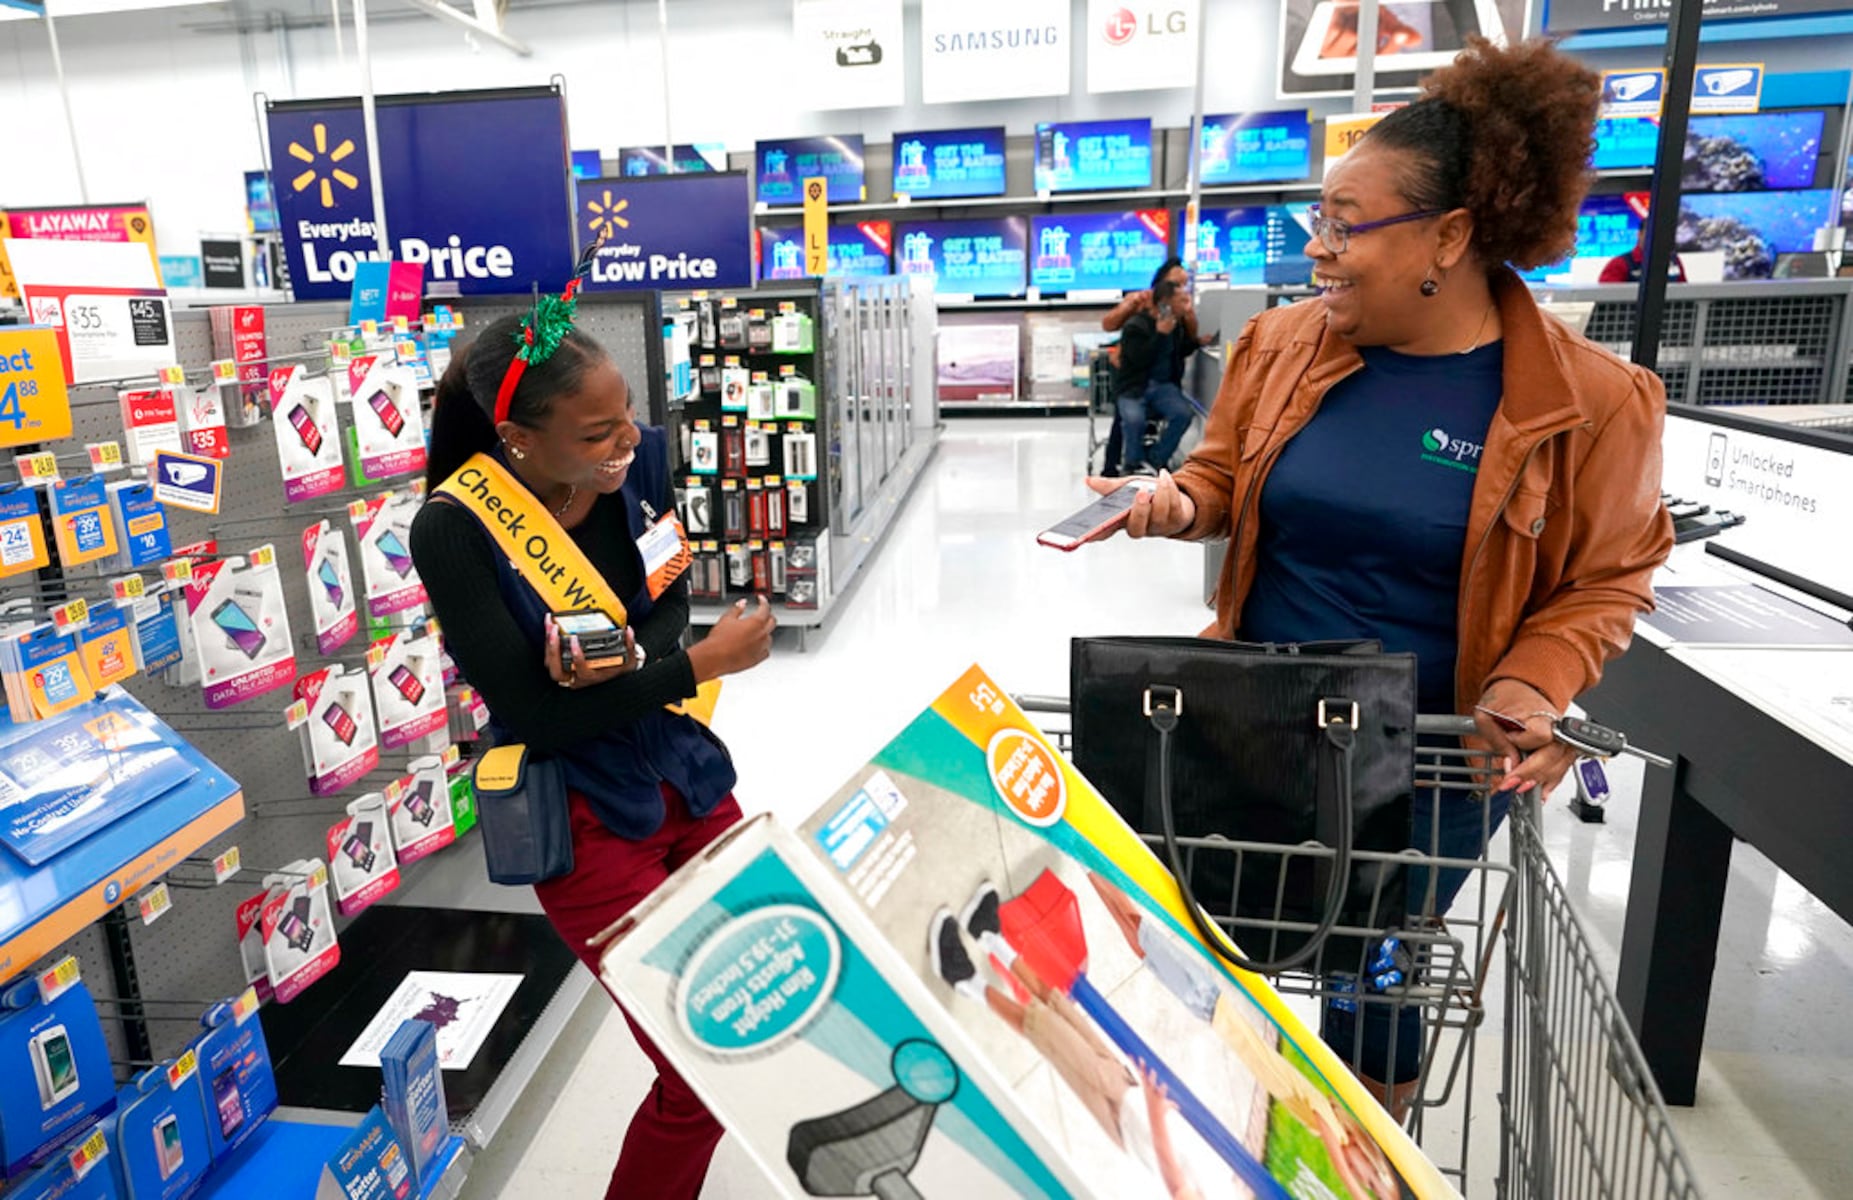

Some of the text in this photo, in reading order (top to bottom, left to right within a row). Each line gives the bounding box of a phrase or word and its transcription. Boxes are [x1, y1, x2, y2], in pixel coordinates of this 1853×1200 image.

[1147, 10, 1186, 35] LG
[823, 28, 872, 41] Straight
[934, 26, 1058, 53] SAMSUNG
[934, 143, 985, 157] GET THE
[1078, 135, 1131, 149] GET THE
[935, 154, 1004, 169] TOP RATED
[1079, 146, 1150, 160] TOP RATED
[29, 212, 109, 233] LAYAWAY
[811, 233, 819, 250] L
[942, 237, 1002, 252] GET THE
[1080, 231, 1143, 246] GET THE
[400, 235, 514, 280] Price
[596, 243, 642, 258] veryday
[943, 249, 1024, 266] TOP RATED
[1081, 246, 1114, 260] TOP
[591, 251, 718, 283] Low Price
[811, 255, 820, 271] 7
[70, 305, 103, 329] $35
[131, 301, 156, 318] $45
[0, 347, 34, 373] act
[192, 430, 217, 448] $35
[1732, 446, 1795, 479] Unlocked
[1728, 471, 1818, 514] Smartphones
[457, 468, 526, 538] Check
[525, 535, 566, 584] Out
[140, 533, 157, 549] $10
[230, 665, 276, 687] UNLIMITED
[107, 884, 117, 900] 3
[710, 941, 807, 1023] Adjusts from
[731, 965, 818, 1038] Rim Height
[350, 1166, 378, 1200] Better
